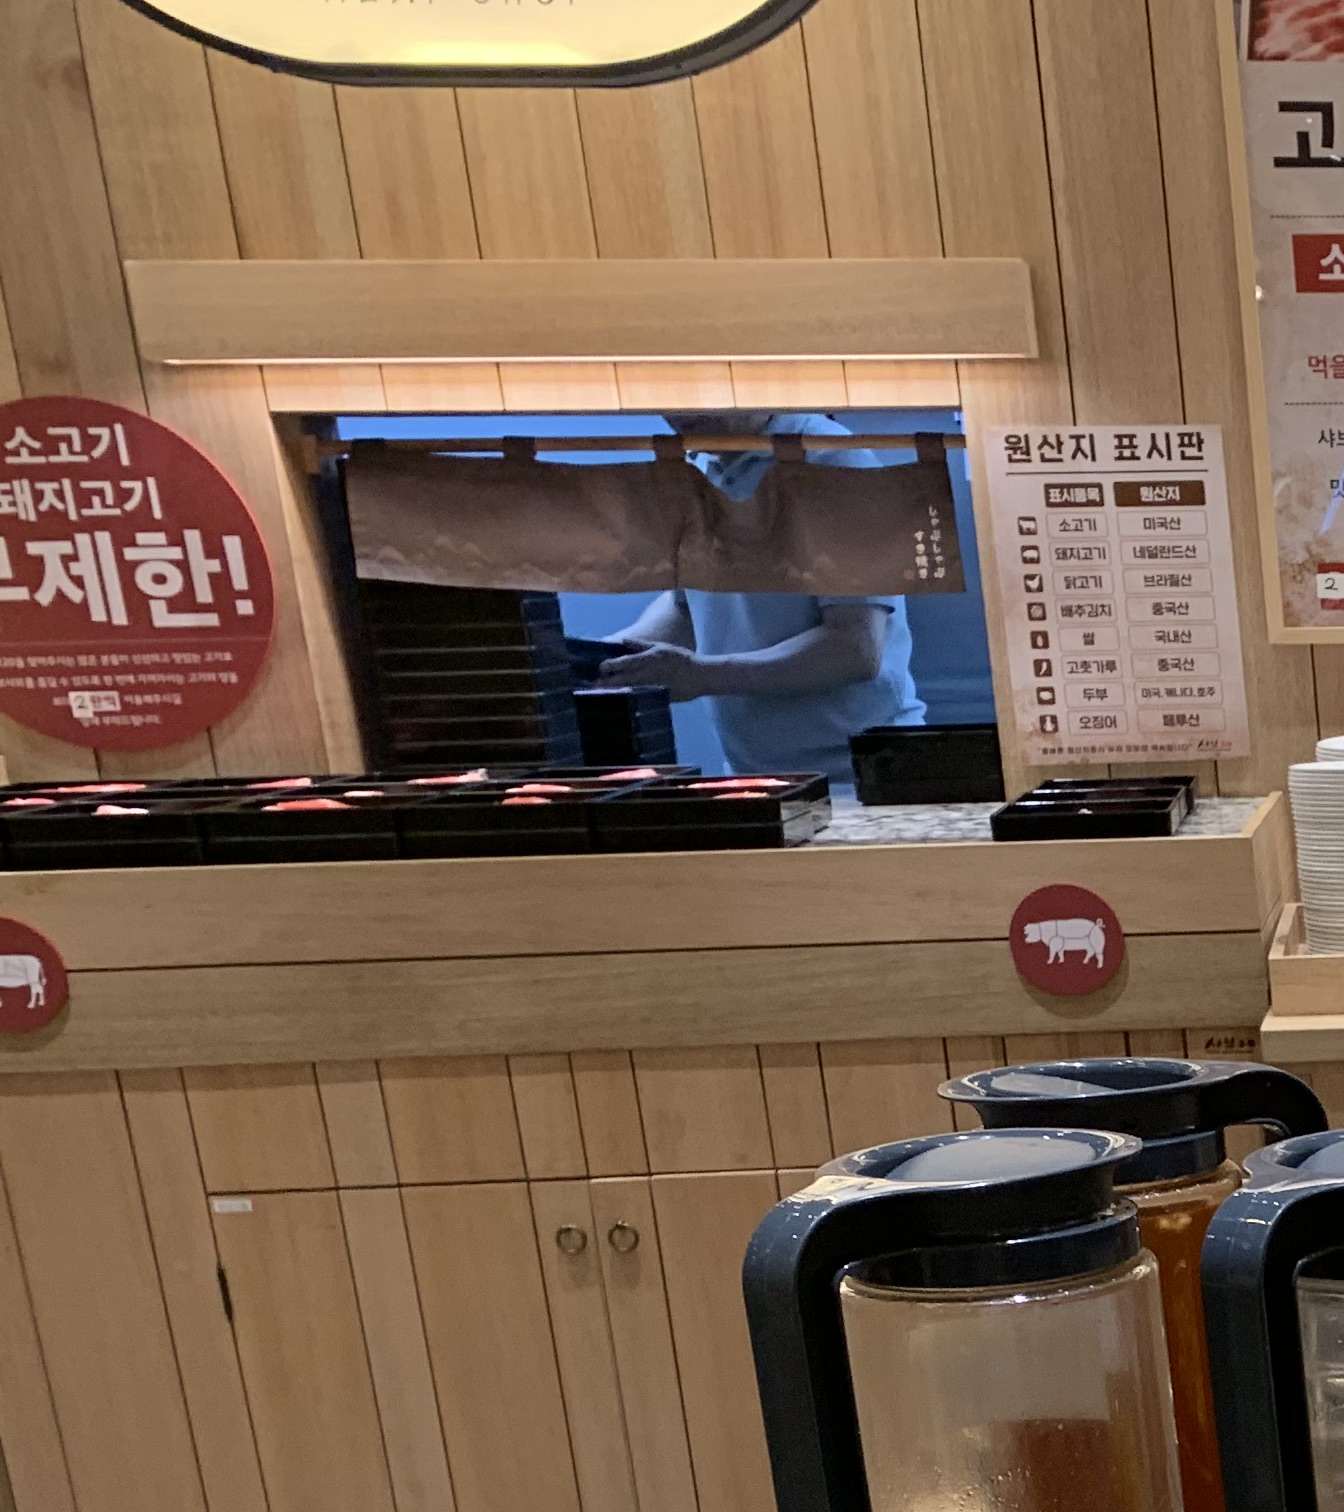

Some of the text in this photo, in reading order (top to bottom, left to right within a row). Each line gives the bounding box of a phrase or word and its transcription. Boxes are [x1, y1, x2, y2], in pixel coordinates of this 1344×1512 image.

[4, 422, 132, 467] 소고기
[1003, 430, 1206, 464] 원산지 표시판
[0, 476, 164, 522] 돼지고기
[1139, 485, 1181, 502] 원산지
[1058, 518, 1098, 532] 소고기
[1142, 516, 1182, 531] 미국산
[1054, 546, 1107, 561] 돼지고기
[1063, 575, 1103, 590] 닭고기
[1151, 601, 1190, 616] 중국산
[1154, 629, 1193, 644] 국내산
[1157, 657, 1195, 672] 중국산
[1082, 687, 1109, 701] 두부
[1079, 715, 1118, 730] 오징어
